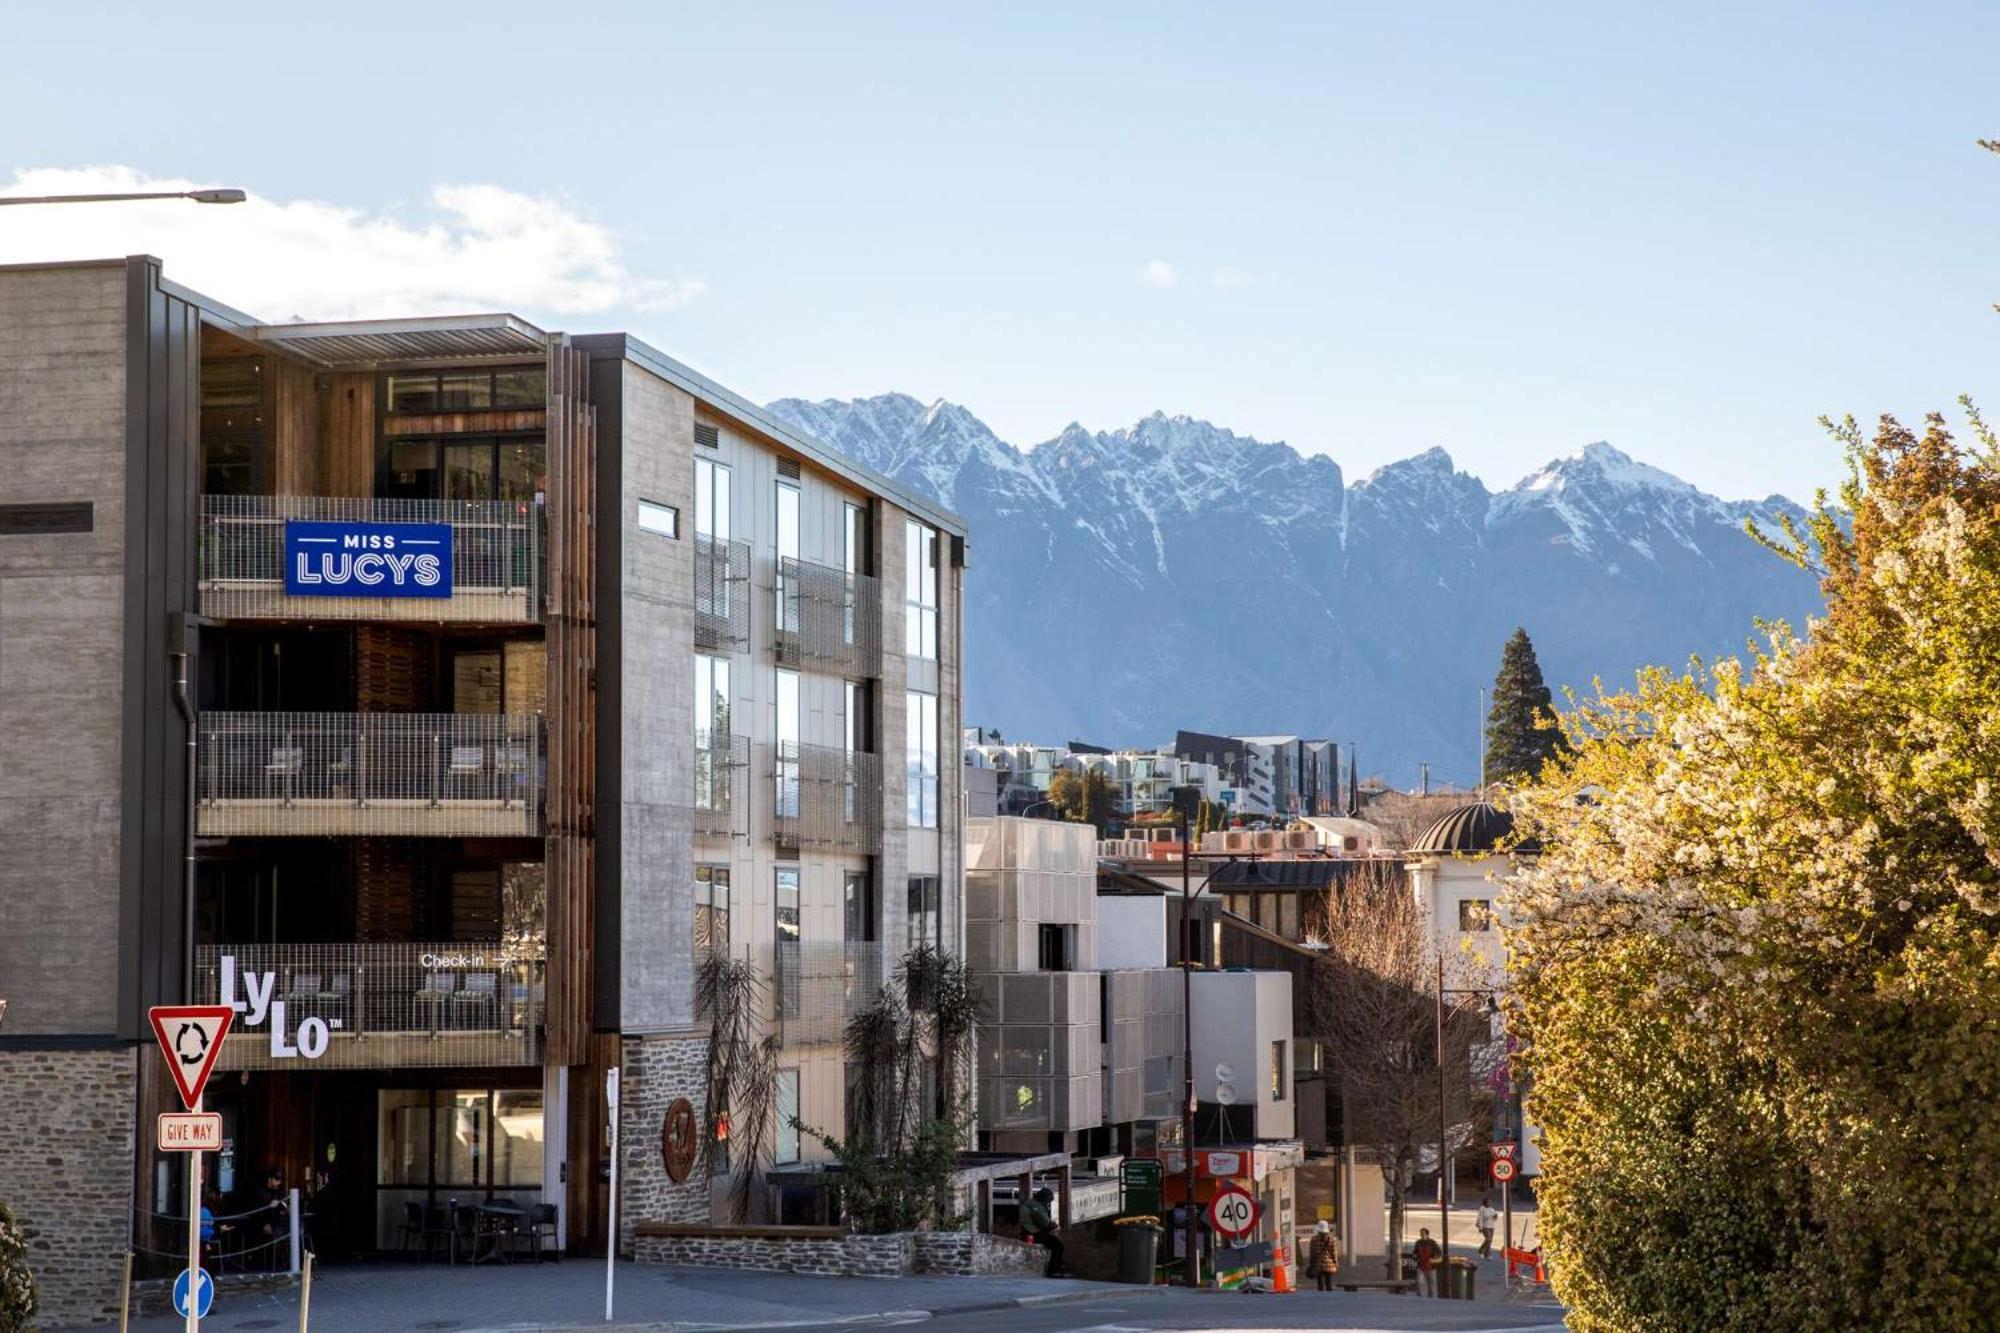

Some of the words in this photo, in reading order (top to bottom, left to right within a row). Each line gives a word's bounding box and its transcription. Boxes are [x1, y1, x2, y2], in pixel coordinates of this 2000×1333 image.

[344, 535, 395, 549] MISS
[297, 552, 441, 586] LUCYS
[421, 953, 485, 968] Check-in
[167, 1124, 189, 1140] GIVE
[192, 1123, 213, 1140] WAY
[1497, 1164, 1509, 1174] 50
[1221, 1201, 1249, 1222] 40
